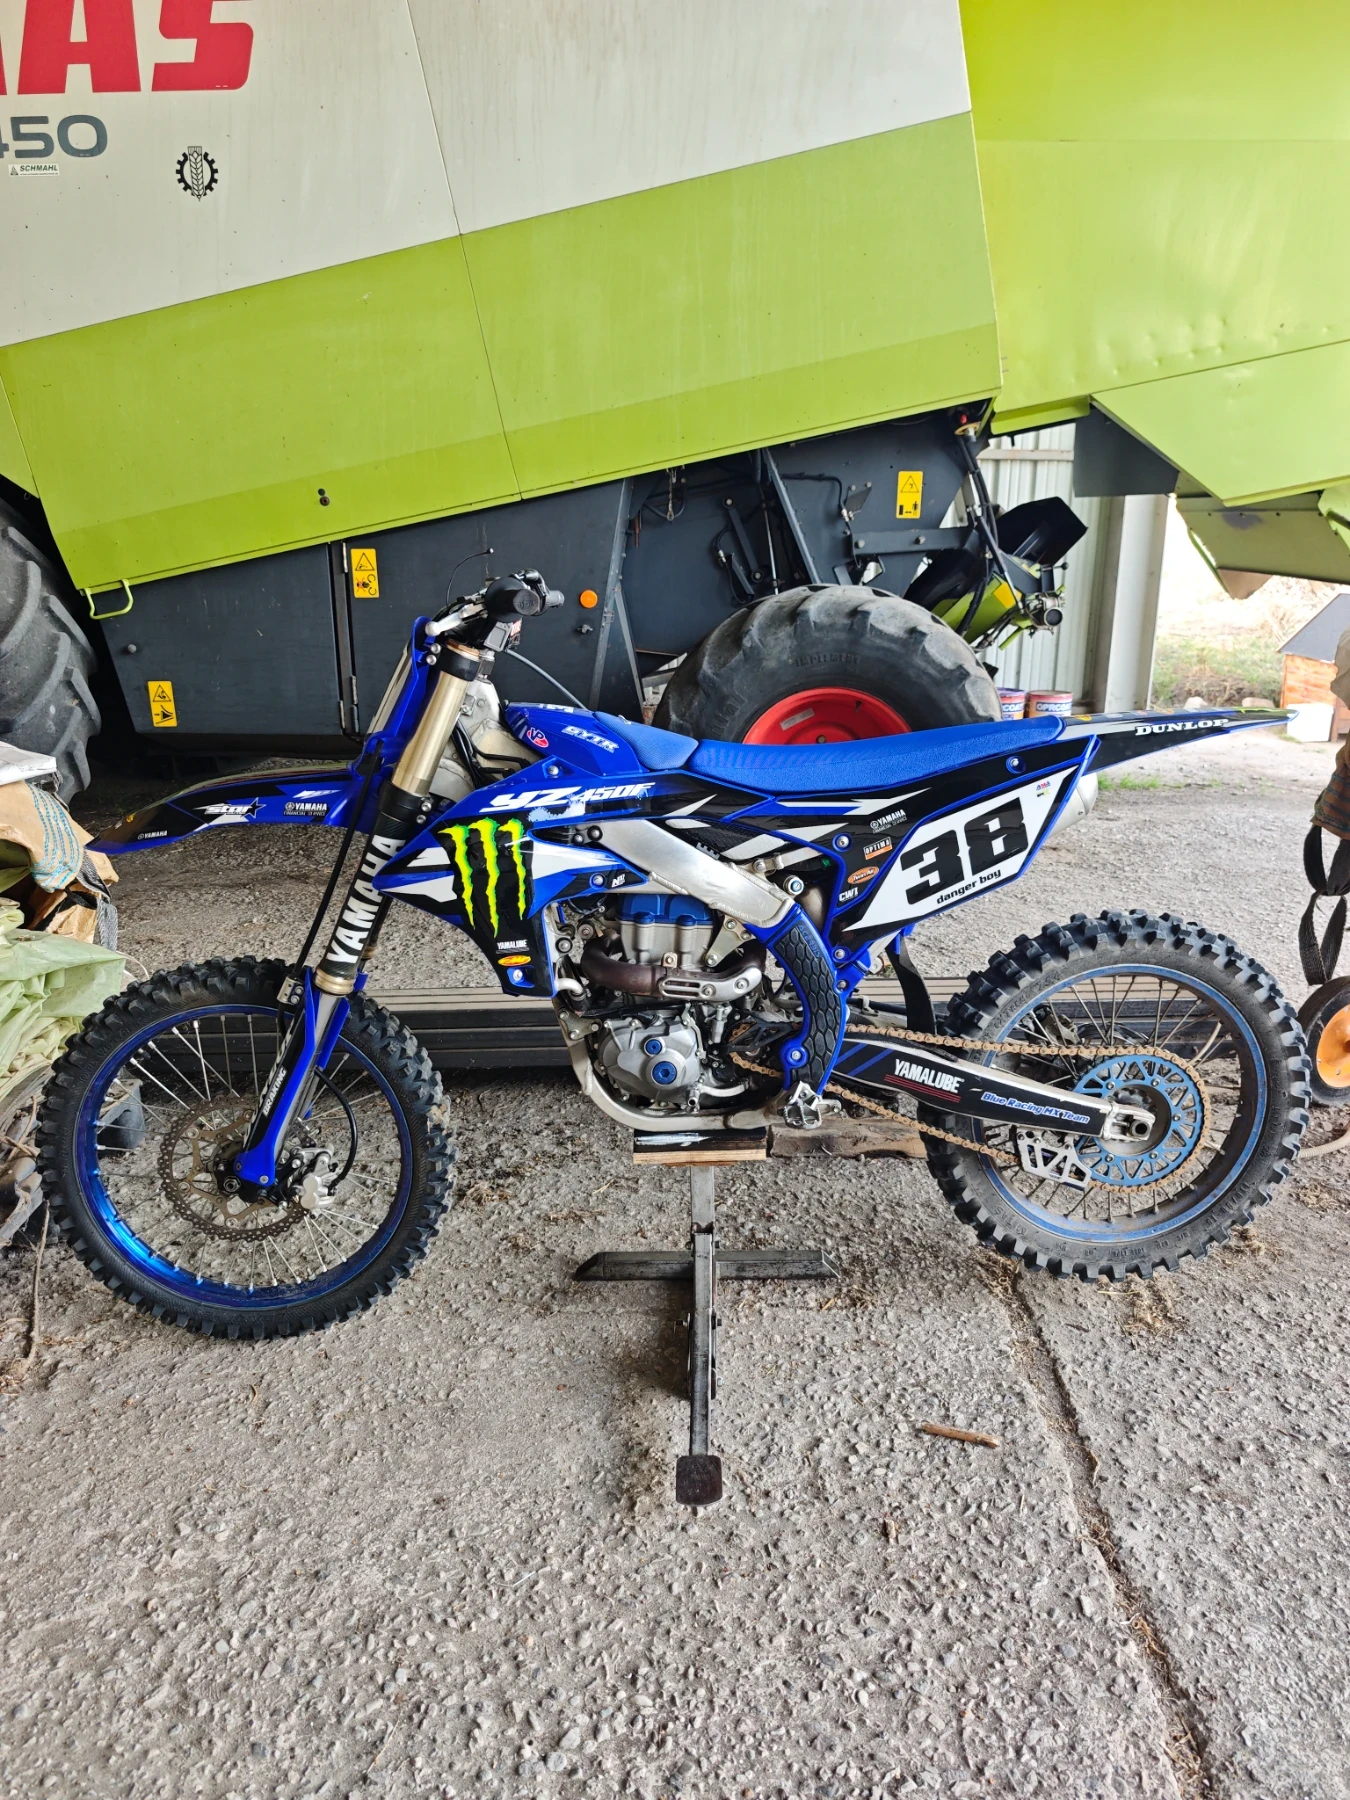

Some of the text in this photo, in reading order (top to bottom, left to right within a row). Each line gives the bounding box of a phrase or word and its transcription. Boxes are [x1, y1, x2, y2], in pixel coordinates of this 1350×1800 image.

[0, 0, 254, 95] AS
[20, 164, 58, 172] SCHMAHL
[1135, 719, 1229, 735] DUNLOP
[295, 802, 327, 811] YAMAHA
[877, 809, 906, 825] YAMAHA
[144, 831, 167, 839] YAMAHA
[865, 838, 890, 855] OPTIMA
[900, 797, 1029, 905] 38
[326, 835, 406, 964] YAMAHA
[936, 869, 1002, 905] danger boy
[497, 940, 528, 950] YAMALUBE
[894, 1058, 961, 1094] YAMALUBE
[262, 1065, 287, 1117] BRAKING
[981, 1091, 1090, 1124] Blue Racing MX Team
